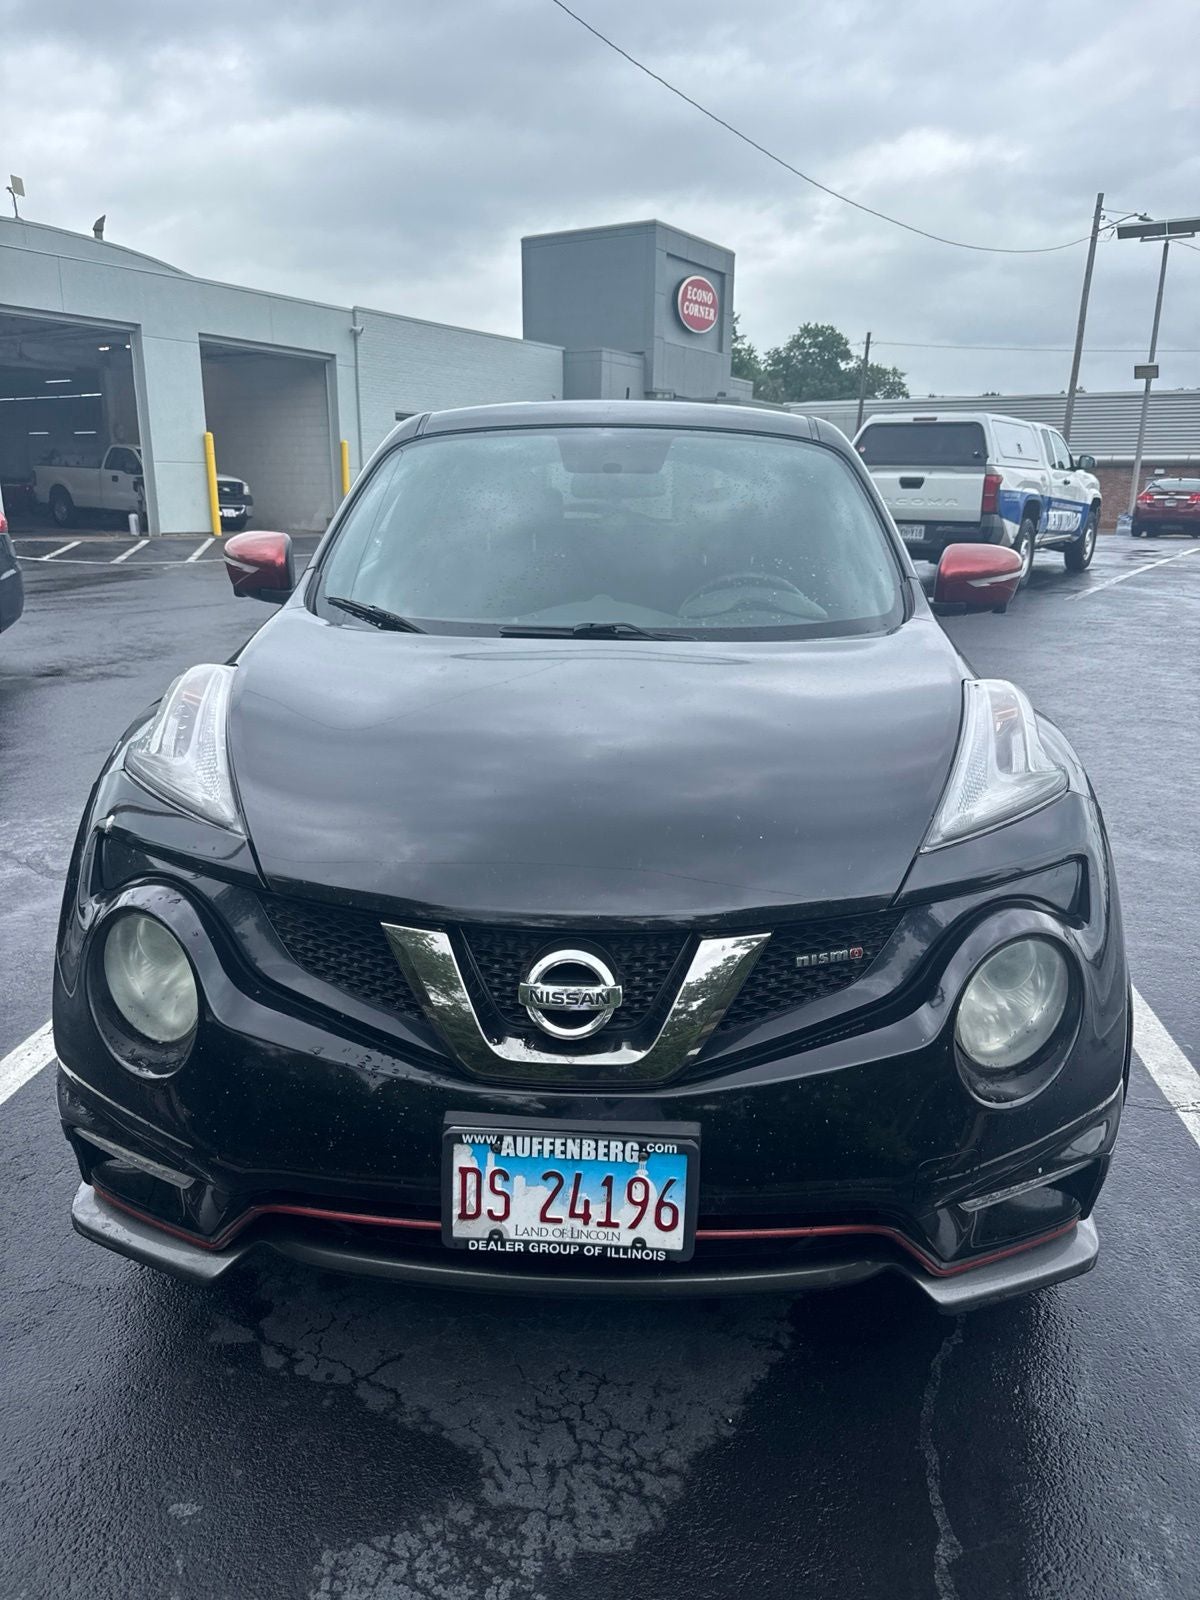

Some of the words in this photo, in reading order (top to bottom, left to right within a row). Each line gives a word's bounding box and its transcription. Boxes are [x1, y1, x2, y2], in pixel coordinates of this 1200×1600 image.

[687, 286, 713, 305] ECONO
[683, 301, 715, 321] CORNER
[881, 497, 959, 507] ACOMA
[529, 989, 610, 1005] NISSAN
[458, 1166, 511, 1222] DS
[540, 1170, 679, 1232] 24196
[515, 1224, 548, 1238] LAND
[570, 1229, 621, 1242] LINCOLN
[468, 1240, 525, 1253] DEALER
[529, 1242, 580, 1256] GROUP
[583, 1245, 604, 1257] OF
[607, 1247, 667, 1261] ILLINOIS
